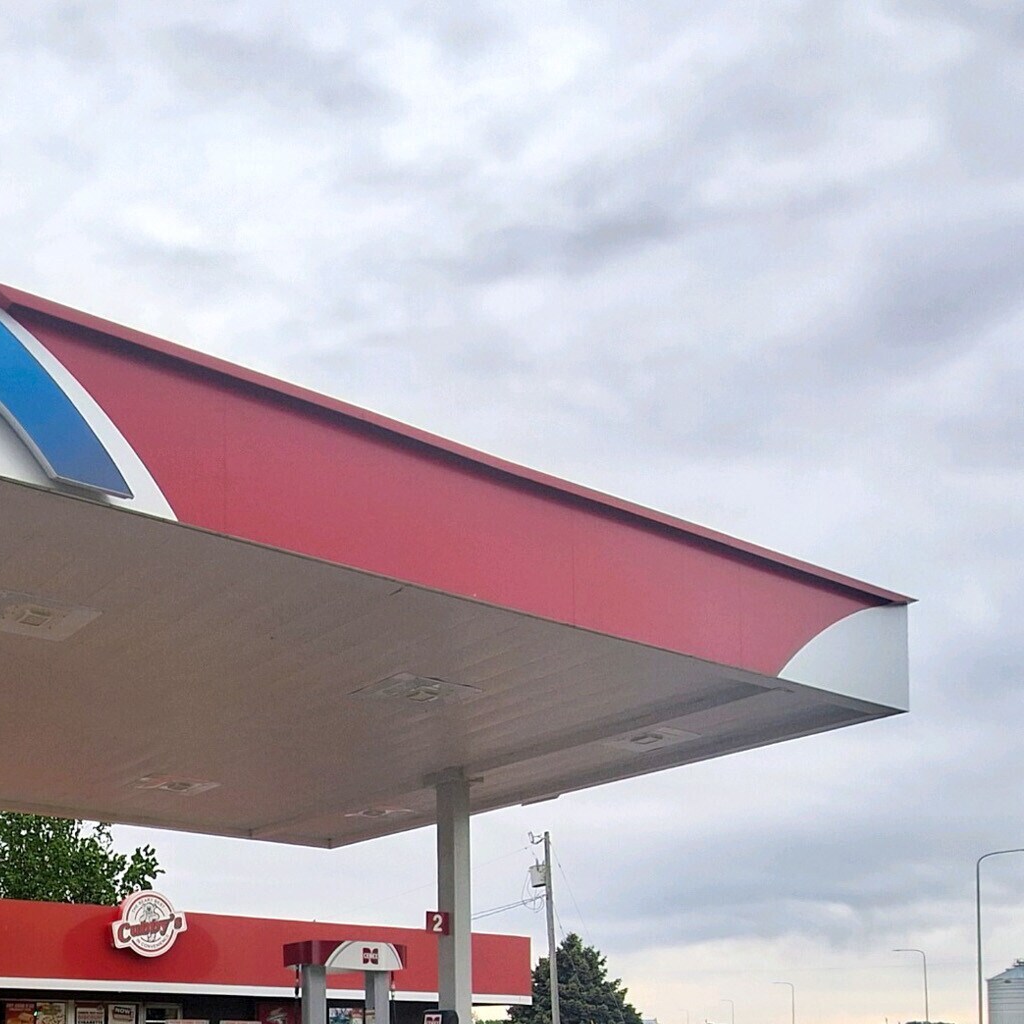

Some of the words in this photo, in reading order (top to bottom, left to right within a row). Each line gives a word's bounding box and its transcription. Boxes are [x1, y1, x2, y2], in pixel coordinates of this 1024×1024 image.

[117, 913, 183, 943] Cubby's
[432, 914, 443, 932] 2
[114, 1007, 131, 1016] NOW
